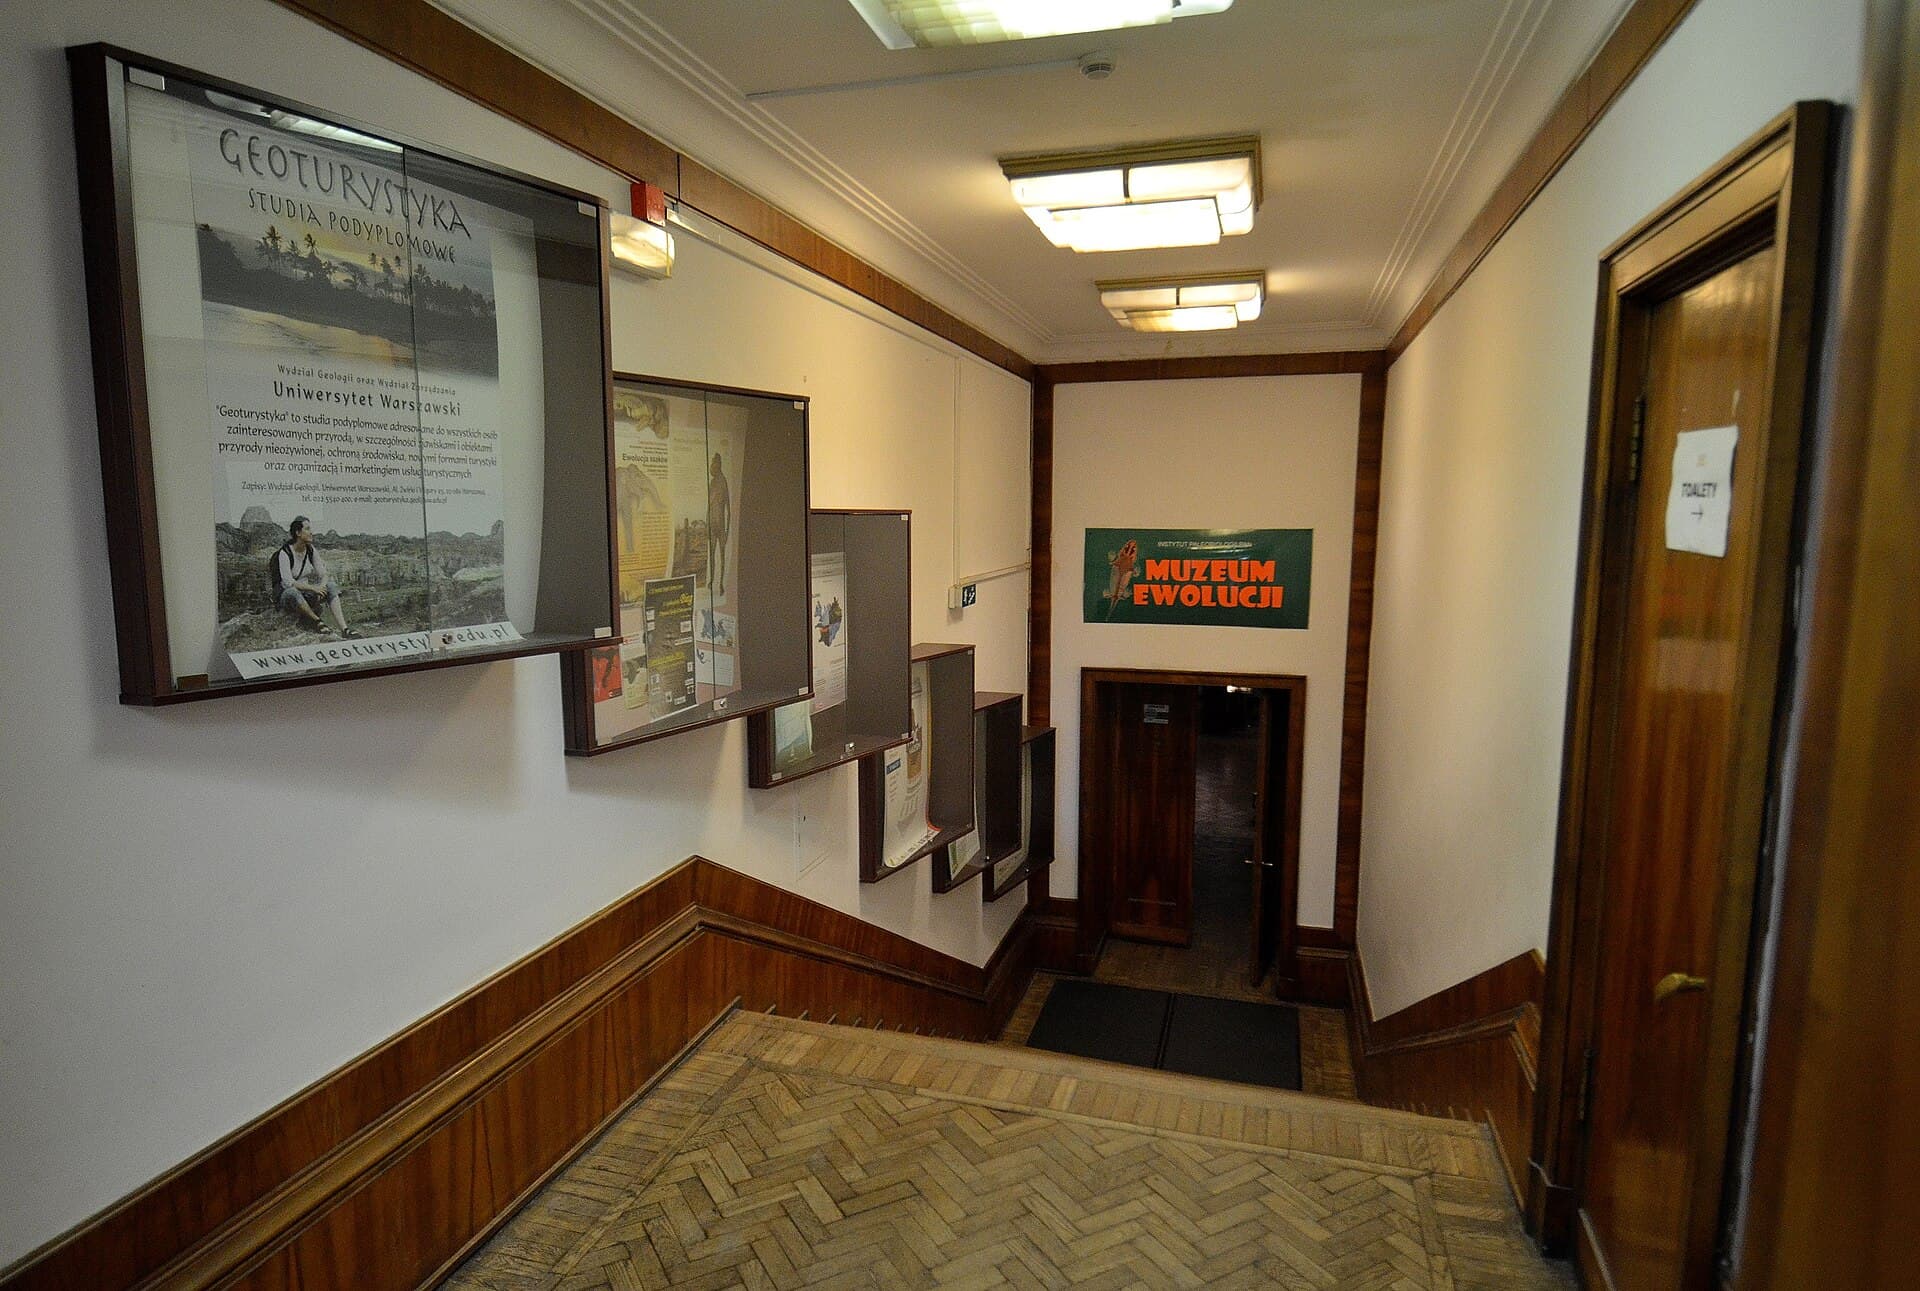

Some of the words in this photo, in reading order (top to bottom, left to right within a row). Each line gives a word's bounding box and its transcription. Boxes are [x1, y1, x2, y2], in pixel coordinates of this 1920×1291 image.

[218, 127, 472, 240] GEOTURYSTYKA
[248, 187, 322, 227] STUDIA
[329, 210, 457, 264] PODYPLOMOWE
[317, 369, 354, 384] Geologii
[356, 376, 375, 385] oraz
[273, 380, 373, 407] Uniwersytet
[380, 393, 461, 417] Warszawski
[226, 423, 313, 441] zainteresowanych
[356, 435, 363, 443] w
[365, 435, 416, 449] szczególności
[461, 440, 493, 452] obiektami
[291, 413, 301, 423] to
[303, 414, 331, 425] studia
[333, 416, 388, 432] podyplomowe
[389, 421, 434, 435] adresowane
[436, 425, 446, 436] do
[446, 427, 481, 440] wszystkich
[482, 430, 498, 440] osób
[218, 441, 263, 455] przyrody
[327, 446, 360, 460] ochroną
[438, 454, 467, 466] formami
[469, 456, 497, 468] turystyki
[264, 461, 286, 471] oraz
[288, 460, 338, 475] organizacją
[345, 462, 400, 478] marketingiem
[423, 468, 472, 480] turystycznych
[1145, 559, 1277, 583] MUZEUM
[1133, 583, 1284, 609] EWOLUCJI
[252, 624, 510, 670] www.geoturysty.edu.pl
